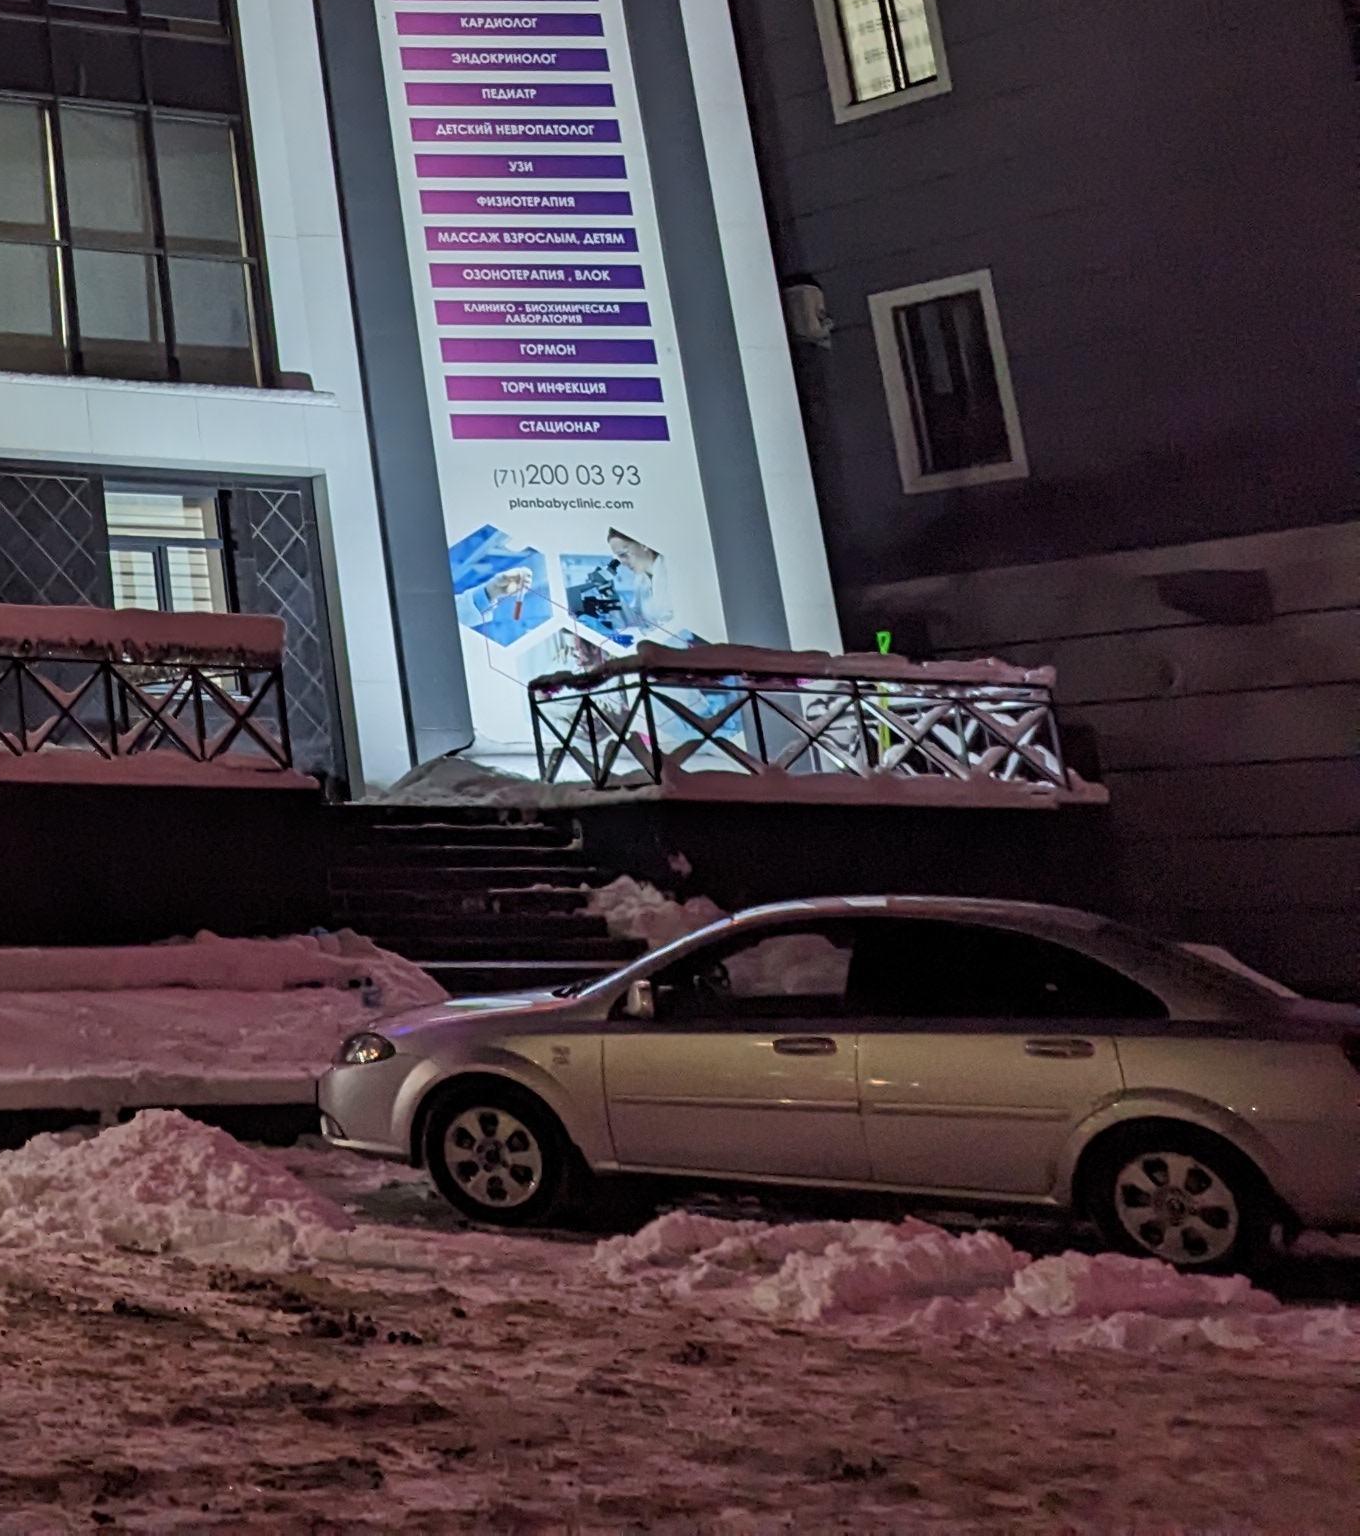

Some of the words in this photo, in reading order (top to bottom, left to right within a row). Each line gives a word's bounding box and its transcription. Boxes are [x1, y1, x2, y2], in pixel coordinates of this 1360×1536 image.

[460, 17, 538, 30] КАРДИОЛОГ
[451, 52, 557, 65] ЭНДОКРИНОЛОГ
[481, 88, 537, 101] ПЕДИАТР
[436, 122, 493, 136] ДЕТСКИЙ
[496, 124, 595, 135] НЕВРОПАТОЛОГ
[508, 161, 534, 173] УЗИ
[476, 196, 576, 208] ФИЗИОТЕРАПИЯ
[437, 232, 500, 244] МАССАЖ
[583, 233, 626, 246] ДЕТЯМ
[462, 269, 565, 282] ОЗОНОТЕРАПИЯ
[463, 302, 516, 314] КЛИНИКО
[525, 302, 620, 314] БИОХИМИЧЕСКАЯ
[505, 314, 583, 325] ЛАБОРАТОРИЯ
[519, 344, 577, 356] ГОРМОН
[501, 381, 535, 394] ТОРЧ
[537, 382, 607, 396] ИНФЕКЦИЯ
[519, 420, 601, 435] СТАЦИОНАР
[576, 465, 605, 486] 03
[612, 465, 642, 486] 93
[509, 498, 634, 511] planbabyclinic.com
